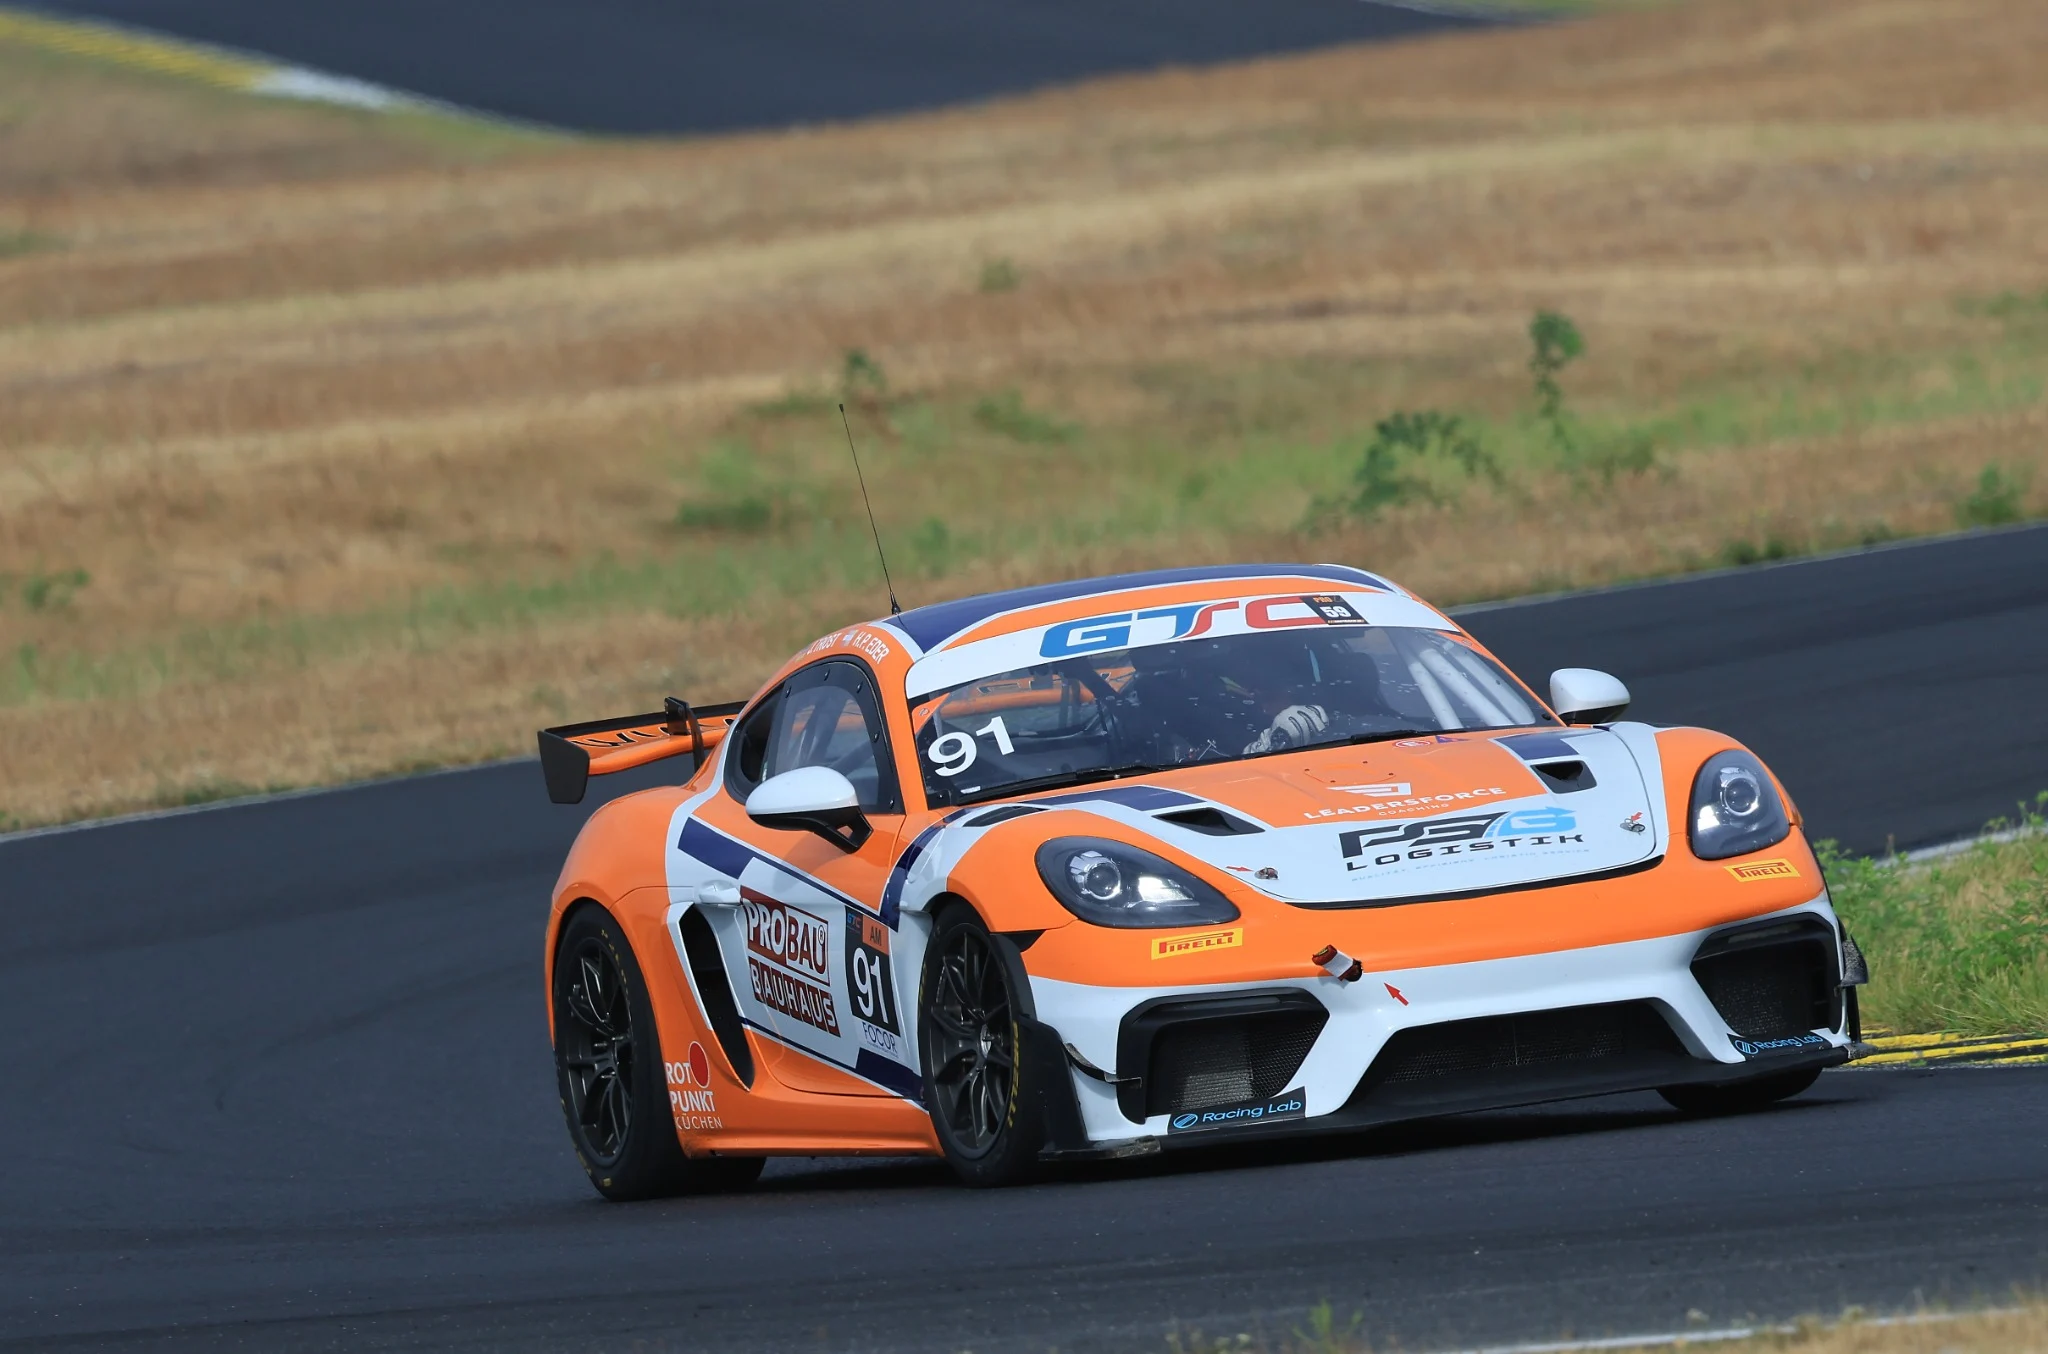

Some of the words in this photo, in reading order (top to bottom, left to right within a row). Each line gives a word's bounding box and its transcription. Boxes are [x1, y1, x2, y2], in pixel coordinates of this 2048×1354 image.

[1320, 606, 1351, 618] 59
[928, 716, 1015, 777] 91
[1304, 787, 1506, 819] LEADERSFORCE
[1378, 803, 1450, 816] COACHING
[1346, 834, 1584, 872] LOGISTIK
[1731, 862, 1792, 878] PIRELLI
[869, 926, 882, 946] AM
[1159, 932, 1234, 954] PIRELLI
[853, 947, 889, 1024] 91
[750, 966, 837, 1028] BAUHAUS
[862, 1021, 898, 1054] FOCOR
[1755, 1038, 1802, 1050] Racing
[664, 1062, 692, 1085] ROT
[669, 1091, 716, 1113] PUNKT
[1202, 1107, 1263, 1123] Racing
[1268, 1099, 1302, 1114] Lab
[674, 1113, 723, 1130] KÜCHEN
